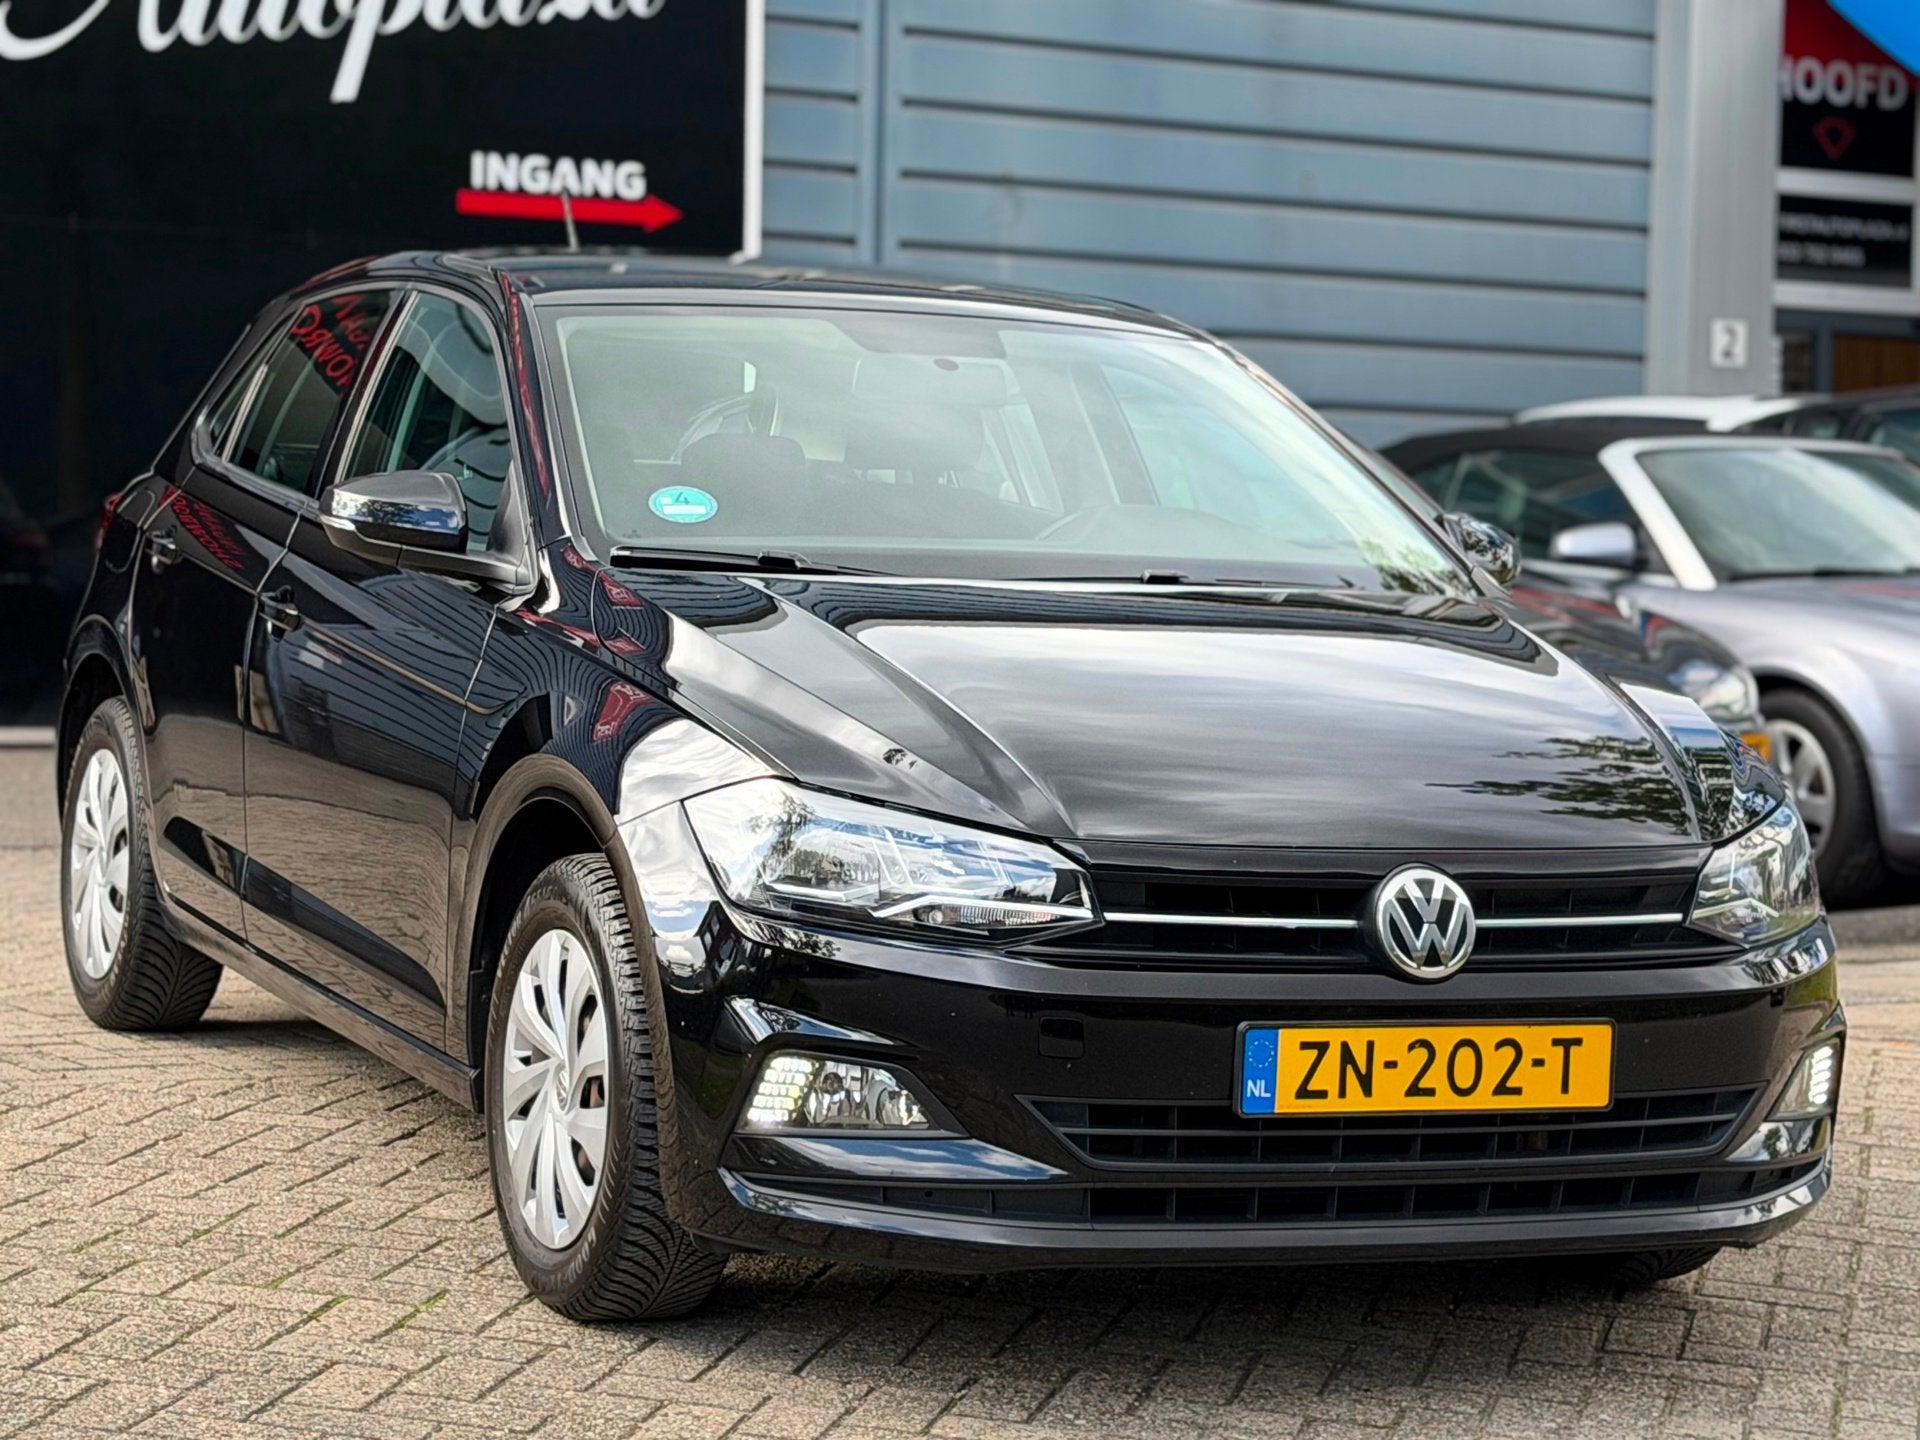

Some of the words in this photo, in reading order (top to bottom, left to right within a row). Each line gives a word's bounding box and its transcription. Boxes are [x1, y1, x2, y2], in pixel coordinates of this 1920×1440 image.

[470, 150, 647, 201] INGANG
[1246, 1079, 1272, 1098] NL
[1294, 1037, 1584, 1100] ZN-202-T
